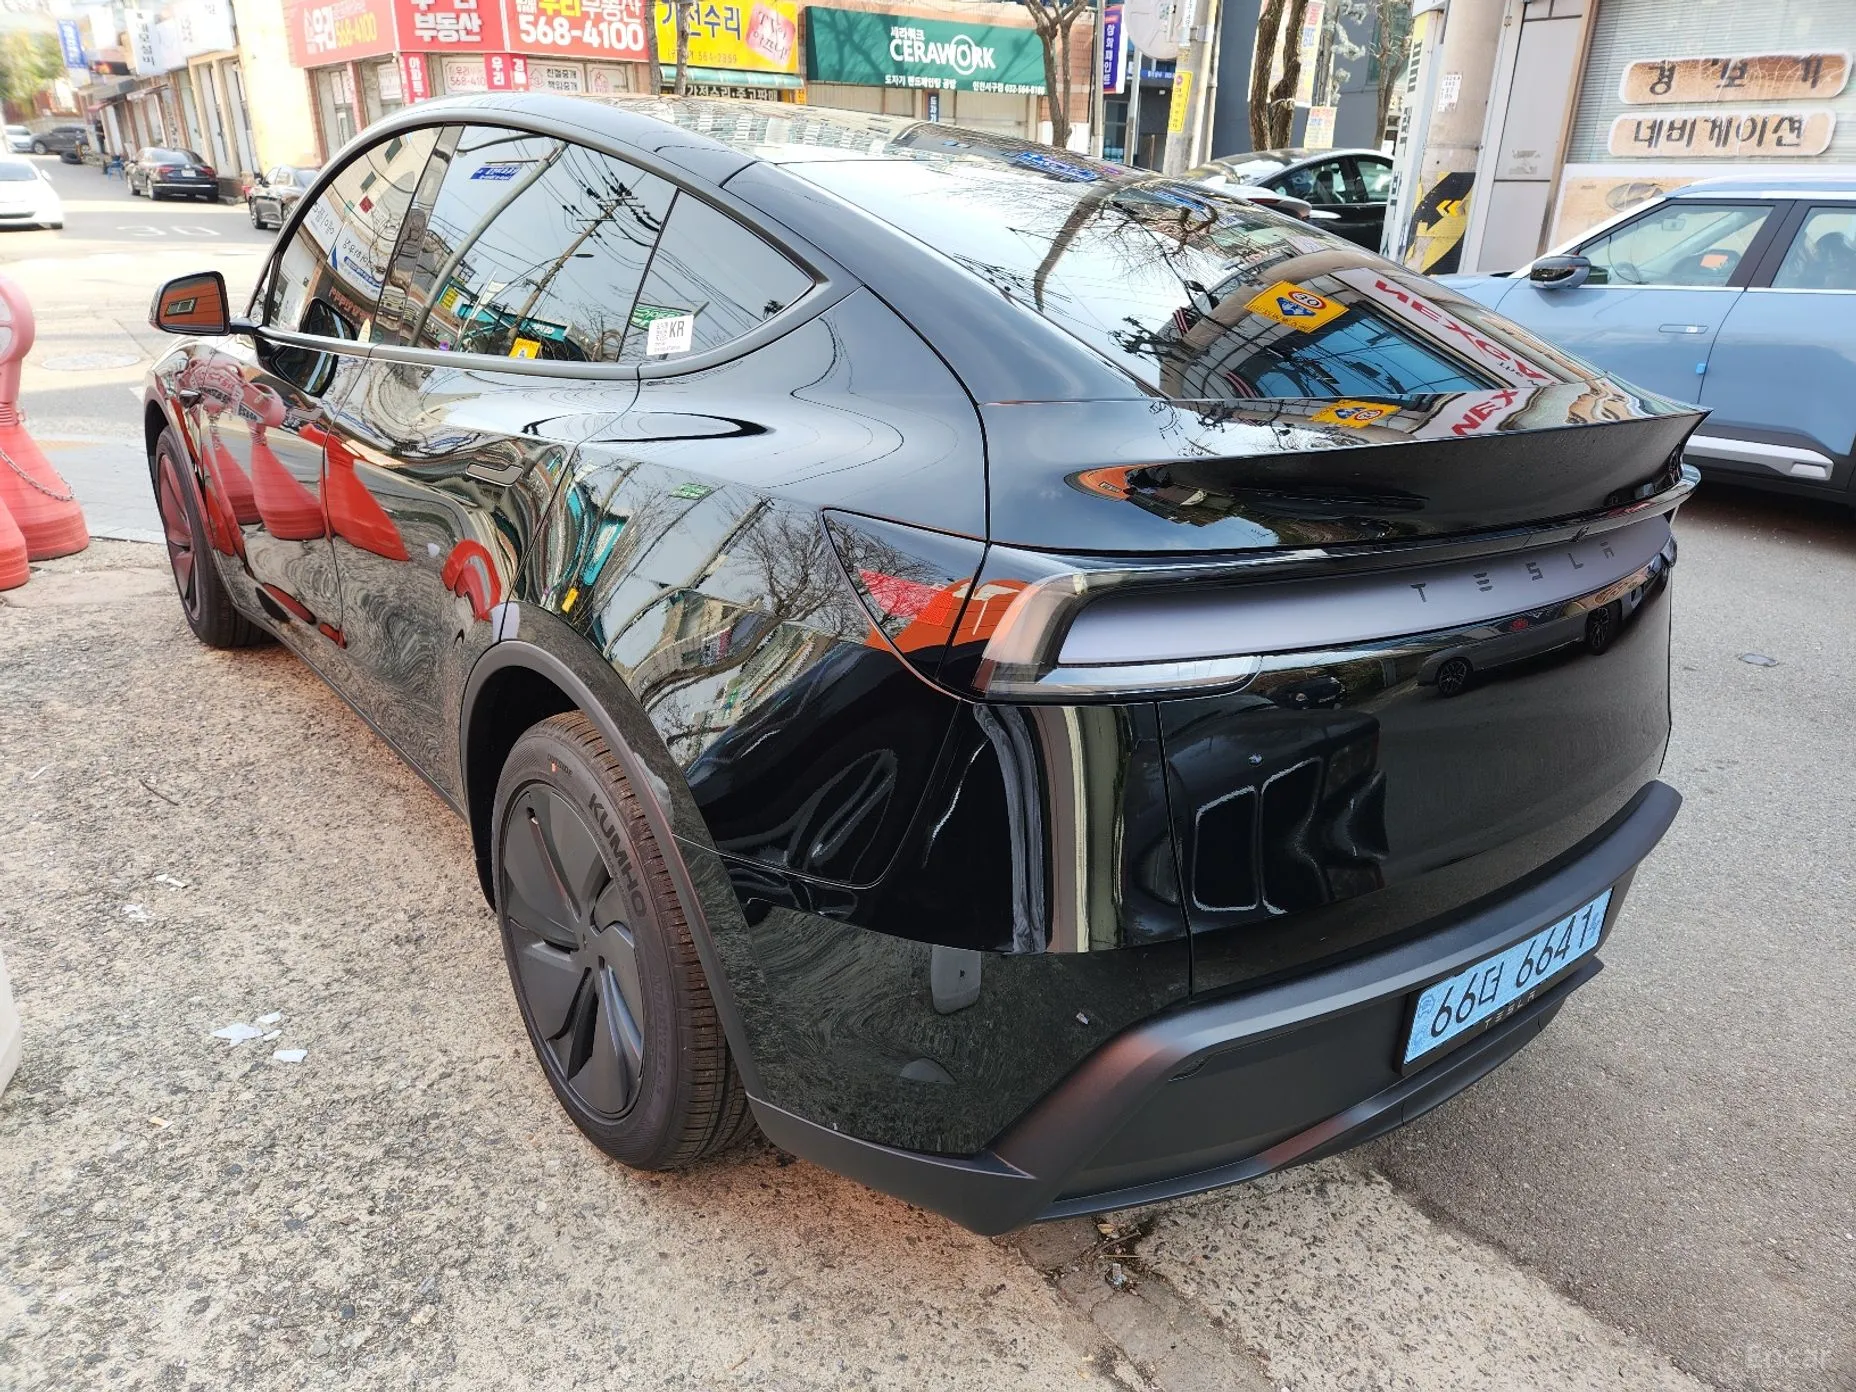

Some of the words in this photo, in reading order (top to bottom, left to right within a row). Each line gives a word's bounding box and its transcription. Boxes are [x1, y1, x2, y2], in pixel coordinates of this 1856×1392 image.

[414, 12, 482, 42] 부동산
[519, 15, 645, 51] 568-4100
[492, 56, 505, 86] 우리
[890, 36, 996, 72] CERAWORK
[450, 75, 485, 87] 568-410
[885, 74, 906, 87] 도자기
[1634, 115, 1803, 149] 네비게이션
[669, 320, 685, 338] KR
[1409, 540, 1616, 603] TESLA
[588, 792, 648, 918] KUMHO
[1515, 904, 1594, 989] 6641
[1484, 989, 1537, 1030] TESLA
